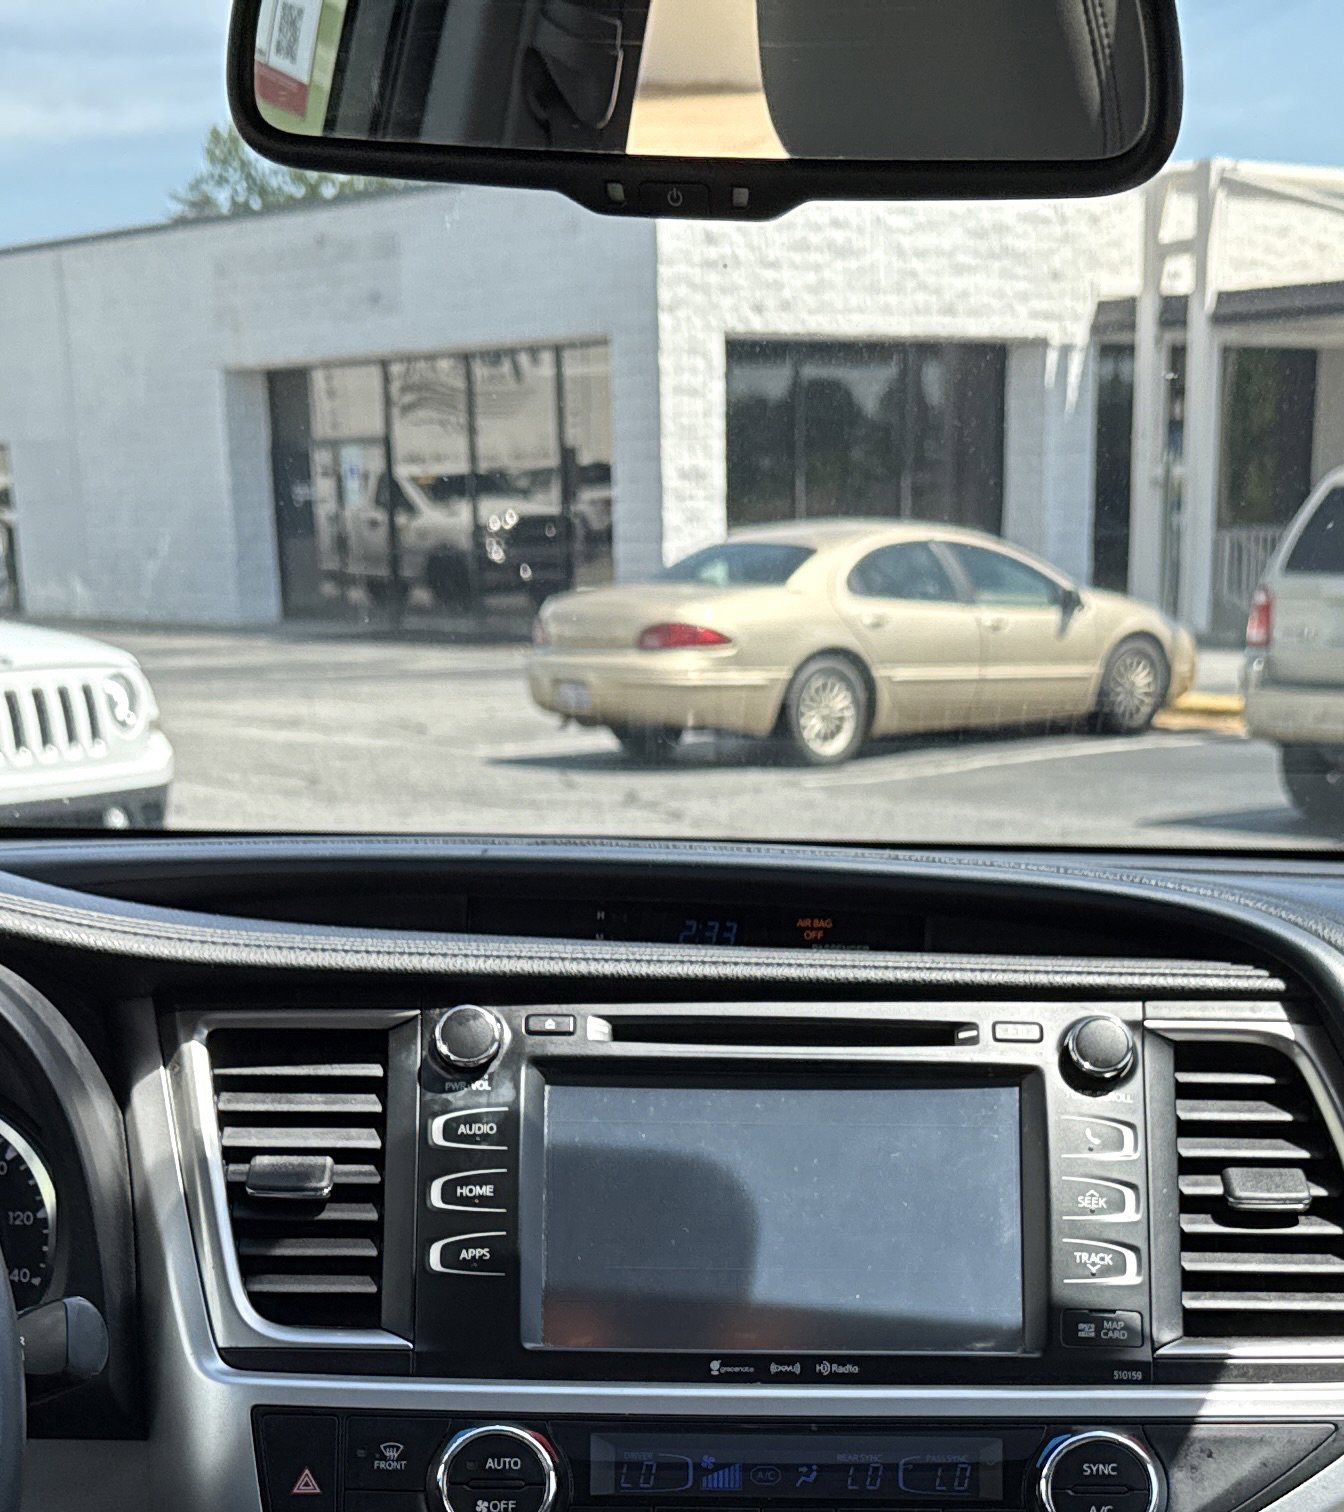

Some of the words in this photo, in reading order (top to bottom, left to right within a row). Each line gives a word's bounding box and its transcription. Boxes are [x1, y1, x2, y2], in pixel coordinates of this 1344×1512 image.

[813, 918, 833, 929] BAG
[804, 930, 824, 940] OFF
[457, 1123, 497, 1135] AUDIO
[457, 1185, 494, 1197] HOME
[1077, 1195, 1107, 1208] SEEK
[8, 1211, 33, 1225] 120
[459, 1248, 490, 1260] APPS
[1073, 1251, 1113, 1265] TRACK
[8, 1266, 31, 1282] 40
[1103, 1320, 1124, 1330] MAP
[1100, 1330, 1128, 1339] CARD
[831, 1362, 859, 1374] Radio
[1113, 1369, 1143, 1380] 510159
[374, 1460, 407, 1470] FRONT
[485, 1458, 522, 1470] AUTO
[1082, 1463, 1118, 1475] SYNC
[757, 1470, 776, 1481] A/C
[489, 1500, 517, 1512] OFF
